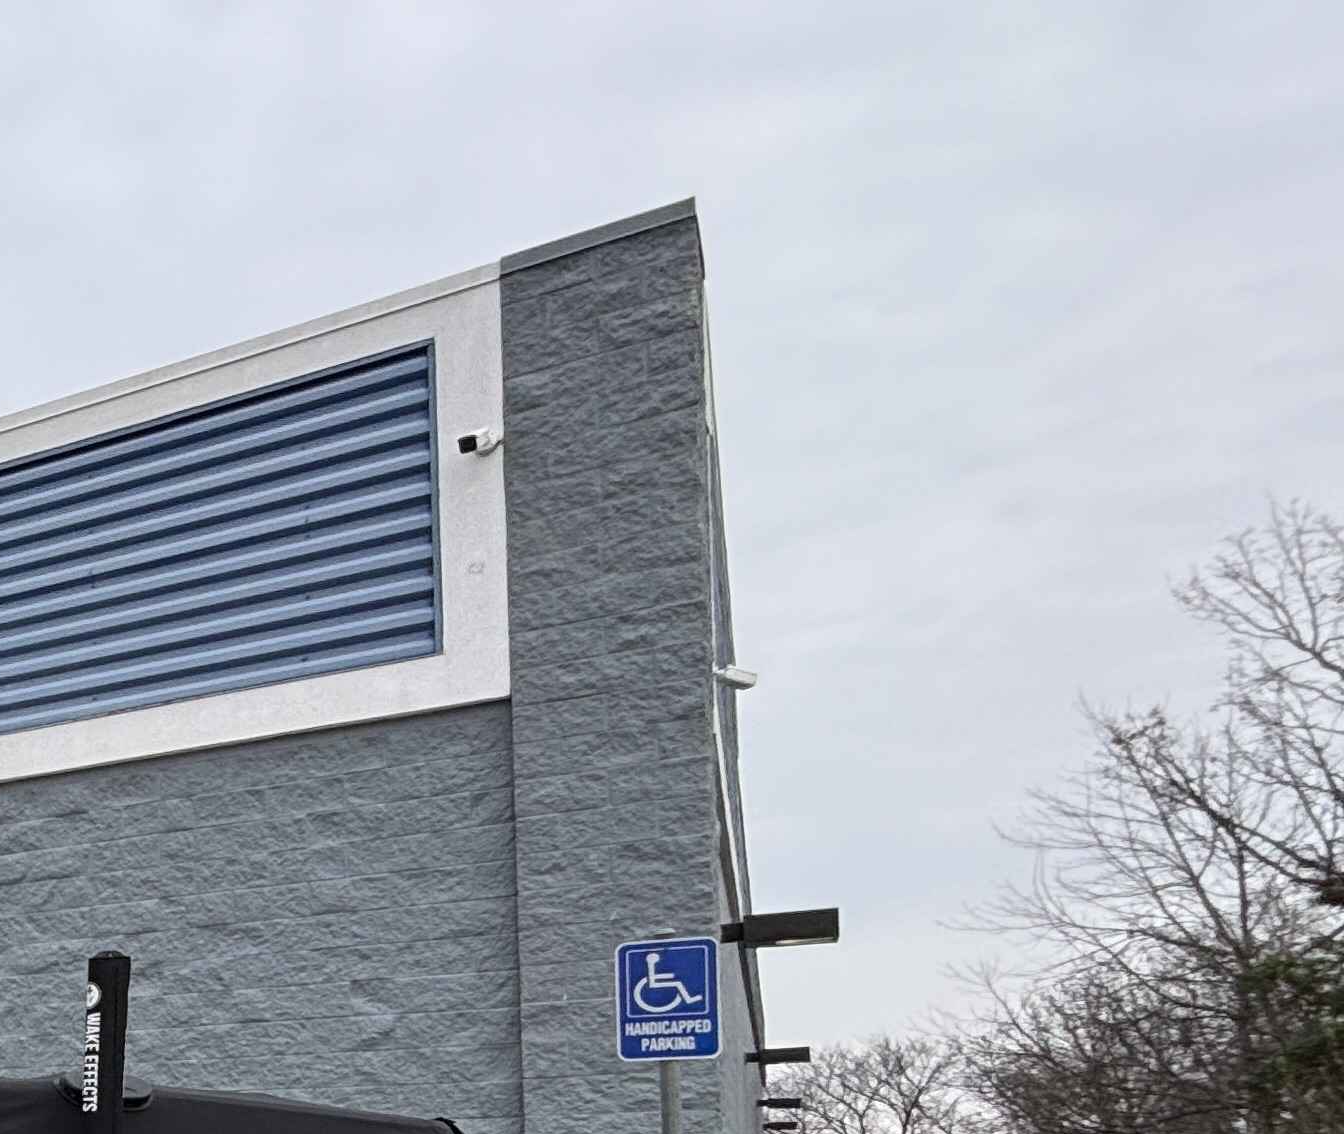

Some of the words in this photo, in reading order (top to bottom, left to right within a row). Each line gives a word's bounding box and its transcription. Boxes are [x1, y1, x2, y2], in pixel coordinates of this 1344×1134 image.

[85, 1012, 101, 1052] WAKE
[625, 1019, 712, 1036] HANDICAPPED
[641, 1036, 696, 1051] PARKING
[82, 1055, 99, 1112] EFFECTS
